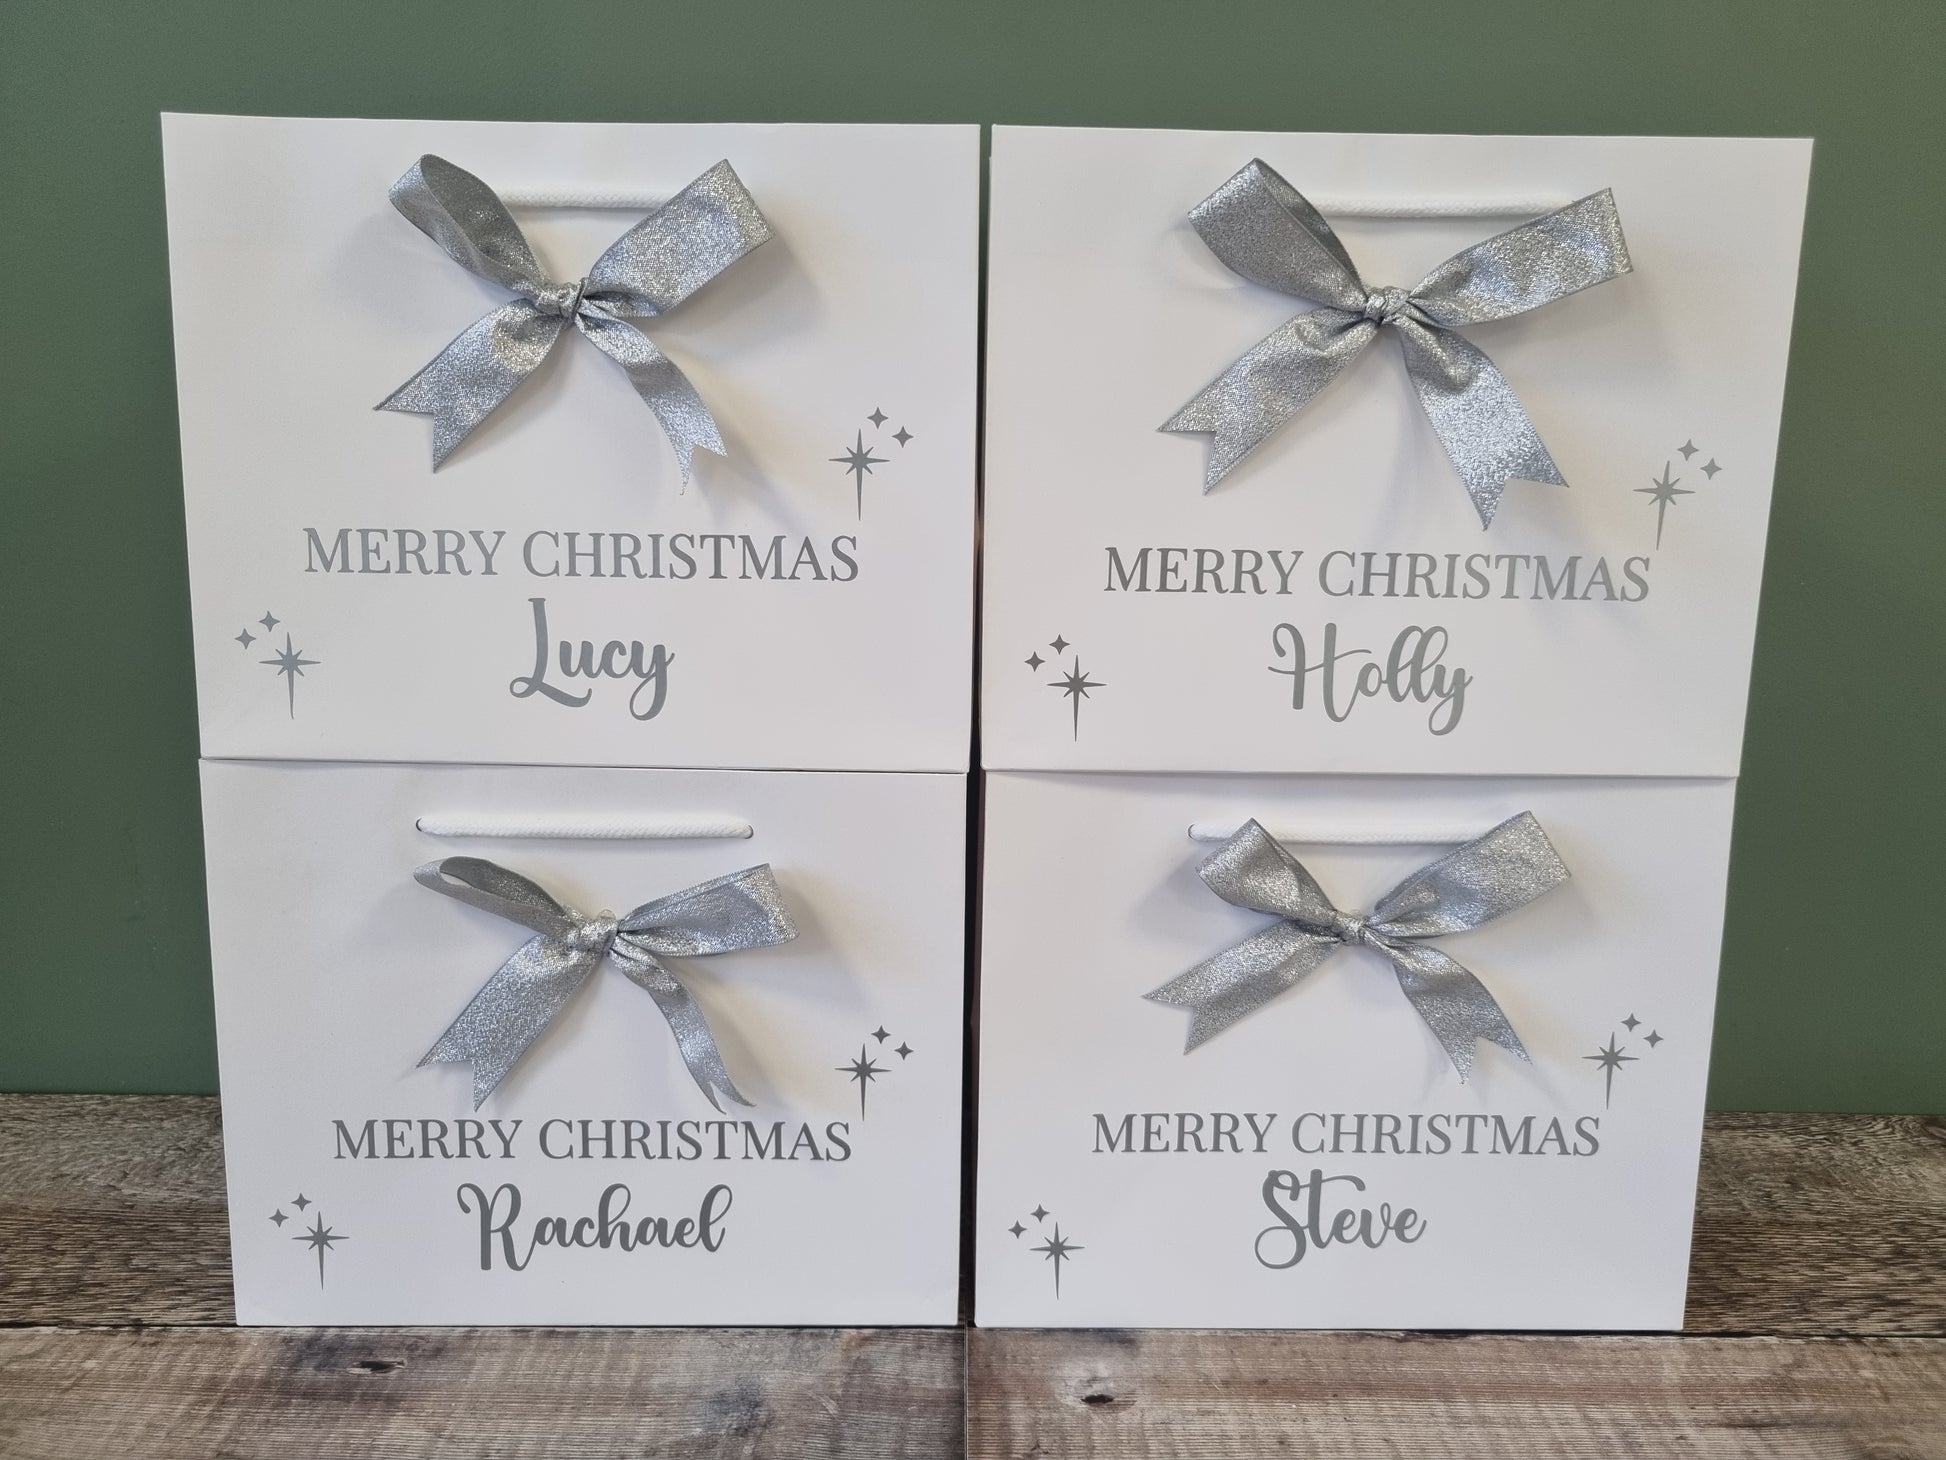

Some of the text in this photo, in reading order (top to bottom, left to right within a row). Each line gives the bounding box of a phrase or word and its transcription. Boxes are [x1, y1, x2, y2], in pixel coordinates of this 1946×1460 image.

[303, 528, 858, 582] MERRY CHRISTMAS
[1104, 547, 1649, 603] MERRY CHRISTMAS
[509, 598, 675, 721] Lucy
[1268, 623, 1473, 736] Holly
[332, 1119, 851, 1163] MERRY CHRISTMAS
[1092, 1113, 1599, 1157] MERRY CHRISTMAS
[457, 1183, 732, 1272] Rachael
[1255, 1169, 1427, 1270] Steve
